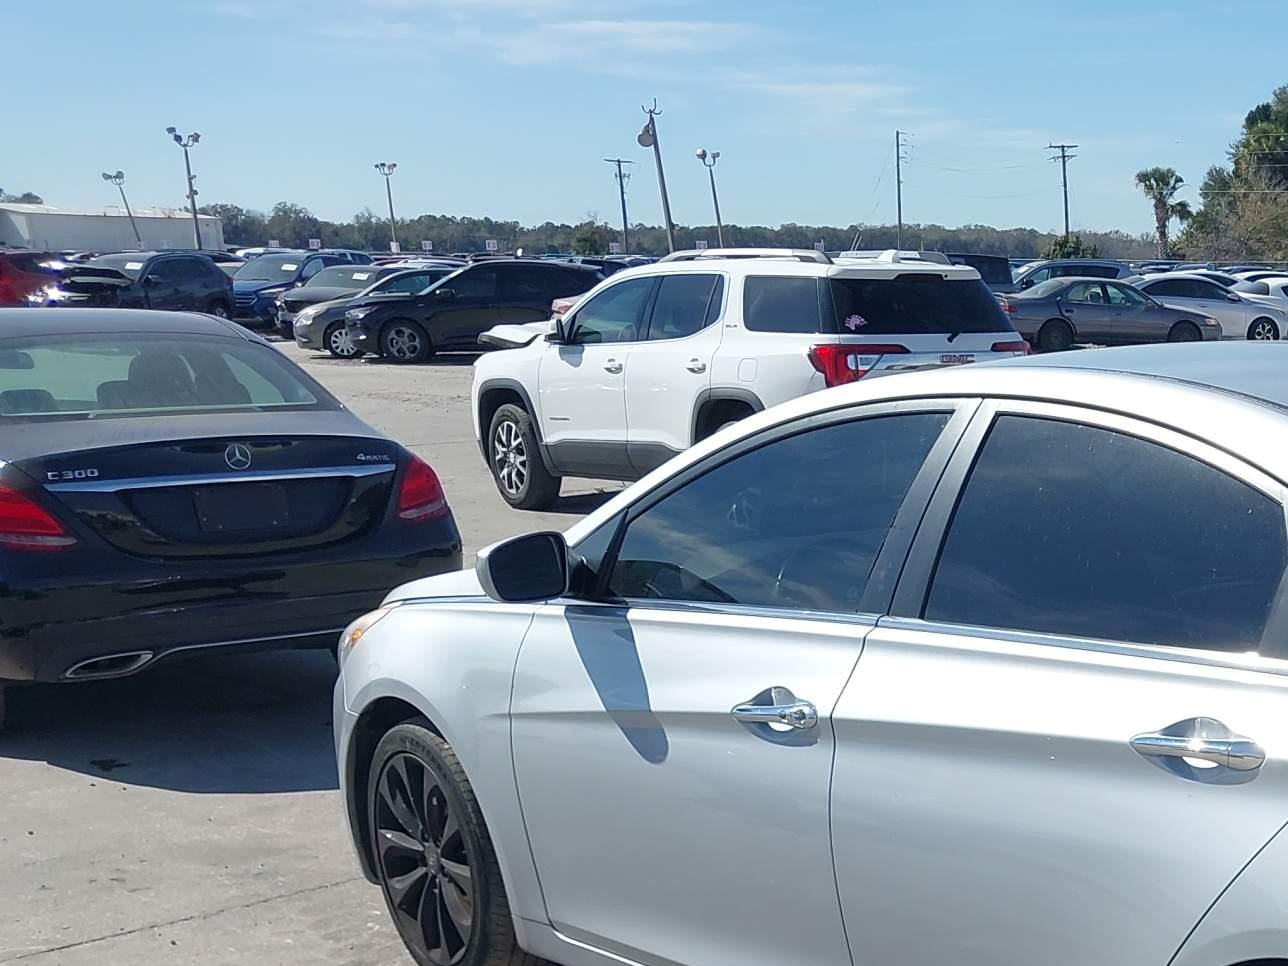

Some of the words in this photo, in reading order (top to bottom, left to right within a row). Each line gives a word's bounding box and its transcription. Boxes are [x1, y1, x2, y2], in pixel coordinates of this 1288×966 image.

[940, 353, 976, 365] GMC
[47, 472, 59, 480] C
[63, 468, 99, 479] 300
